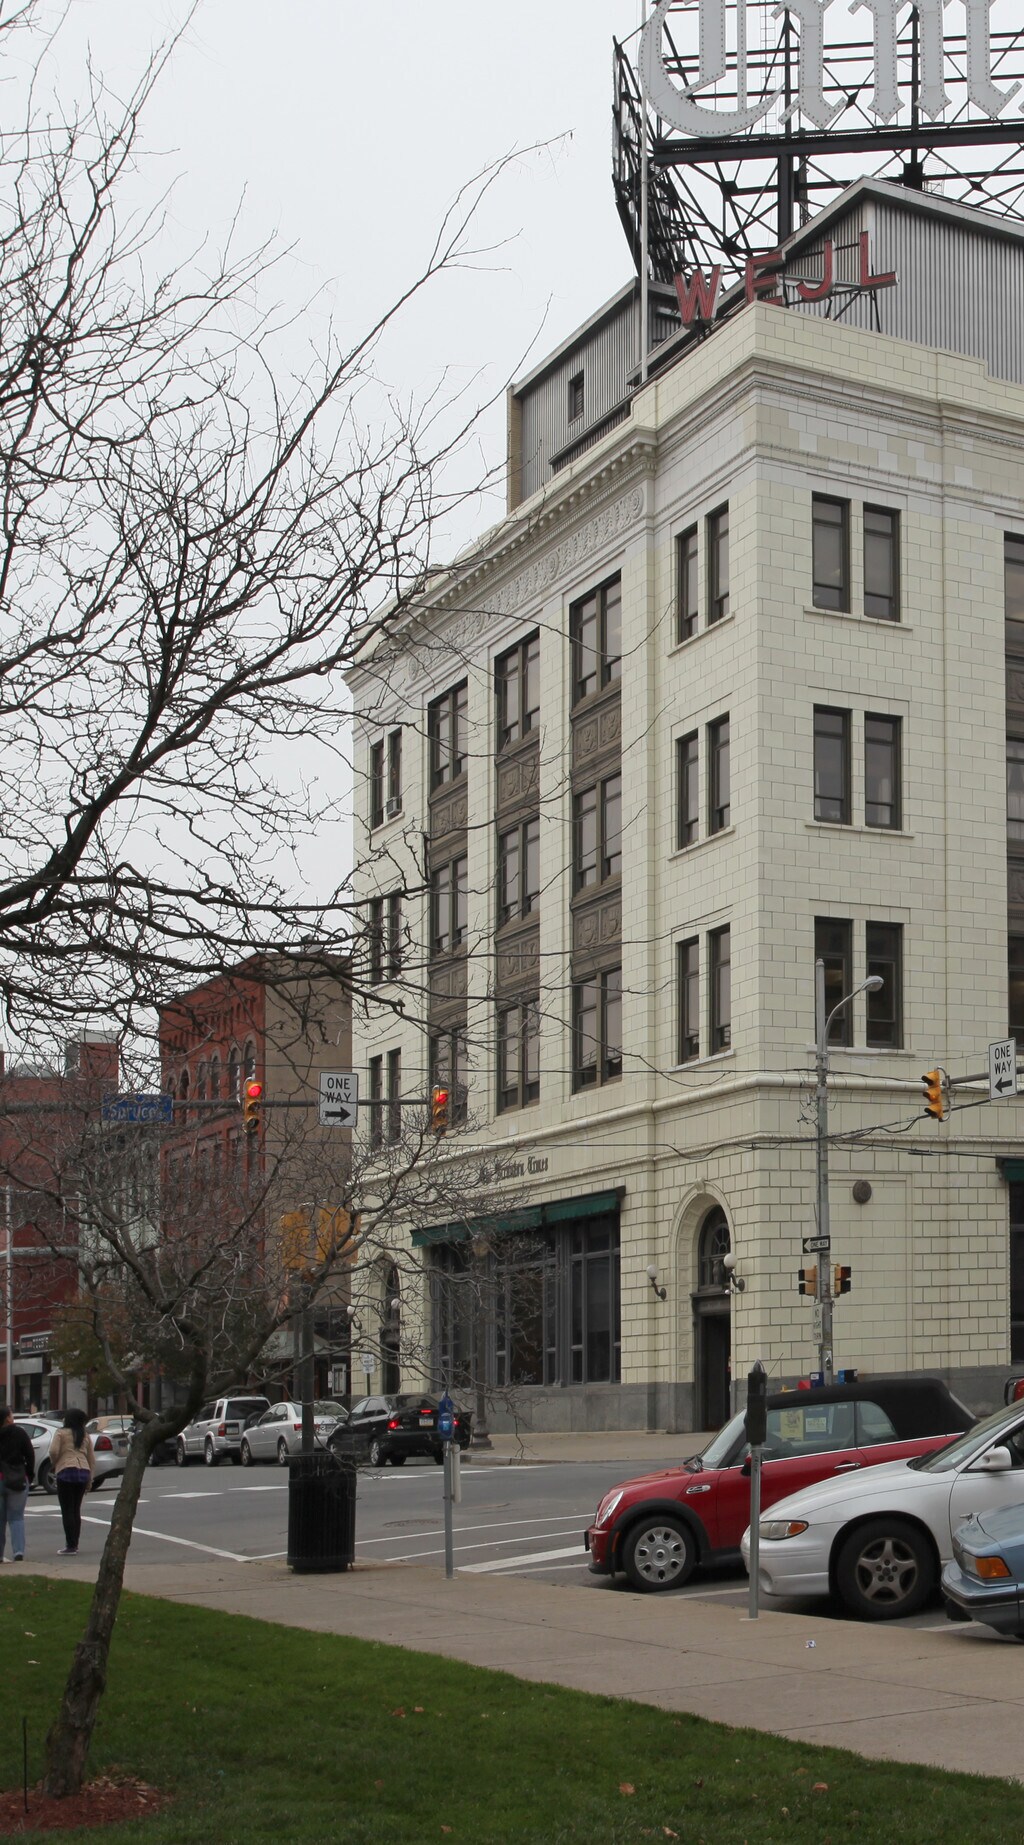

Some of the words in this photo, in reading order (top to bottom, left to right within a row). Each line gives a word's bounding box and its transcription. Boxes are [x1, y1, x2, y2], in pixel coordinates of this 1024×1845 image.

[674, 231, 898, 330] WEJL
[994, 1045, 1011, 1058] ONE
[994, 1060, 1012, 1075] WAY
[327, 1077, 351, 1090] ONE
[325, 1092, 352, 1104] WAY
